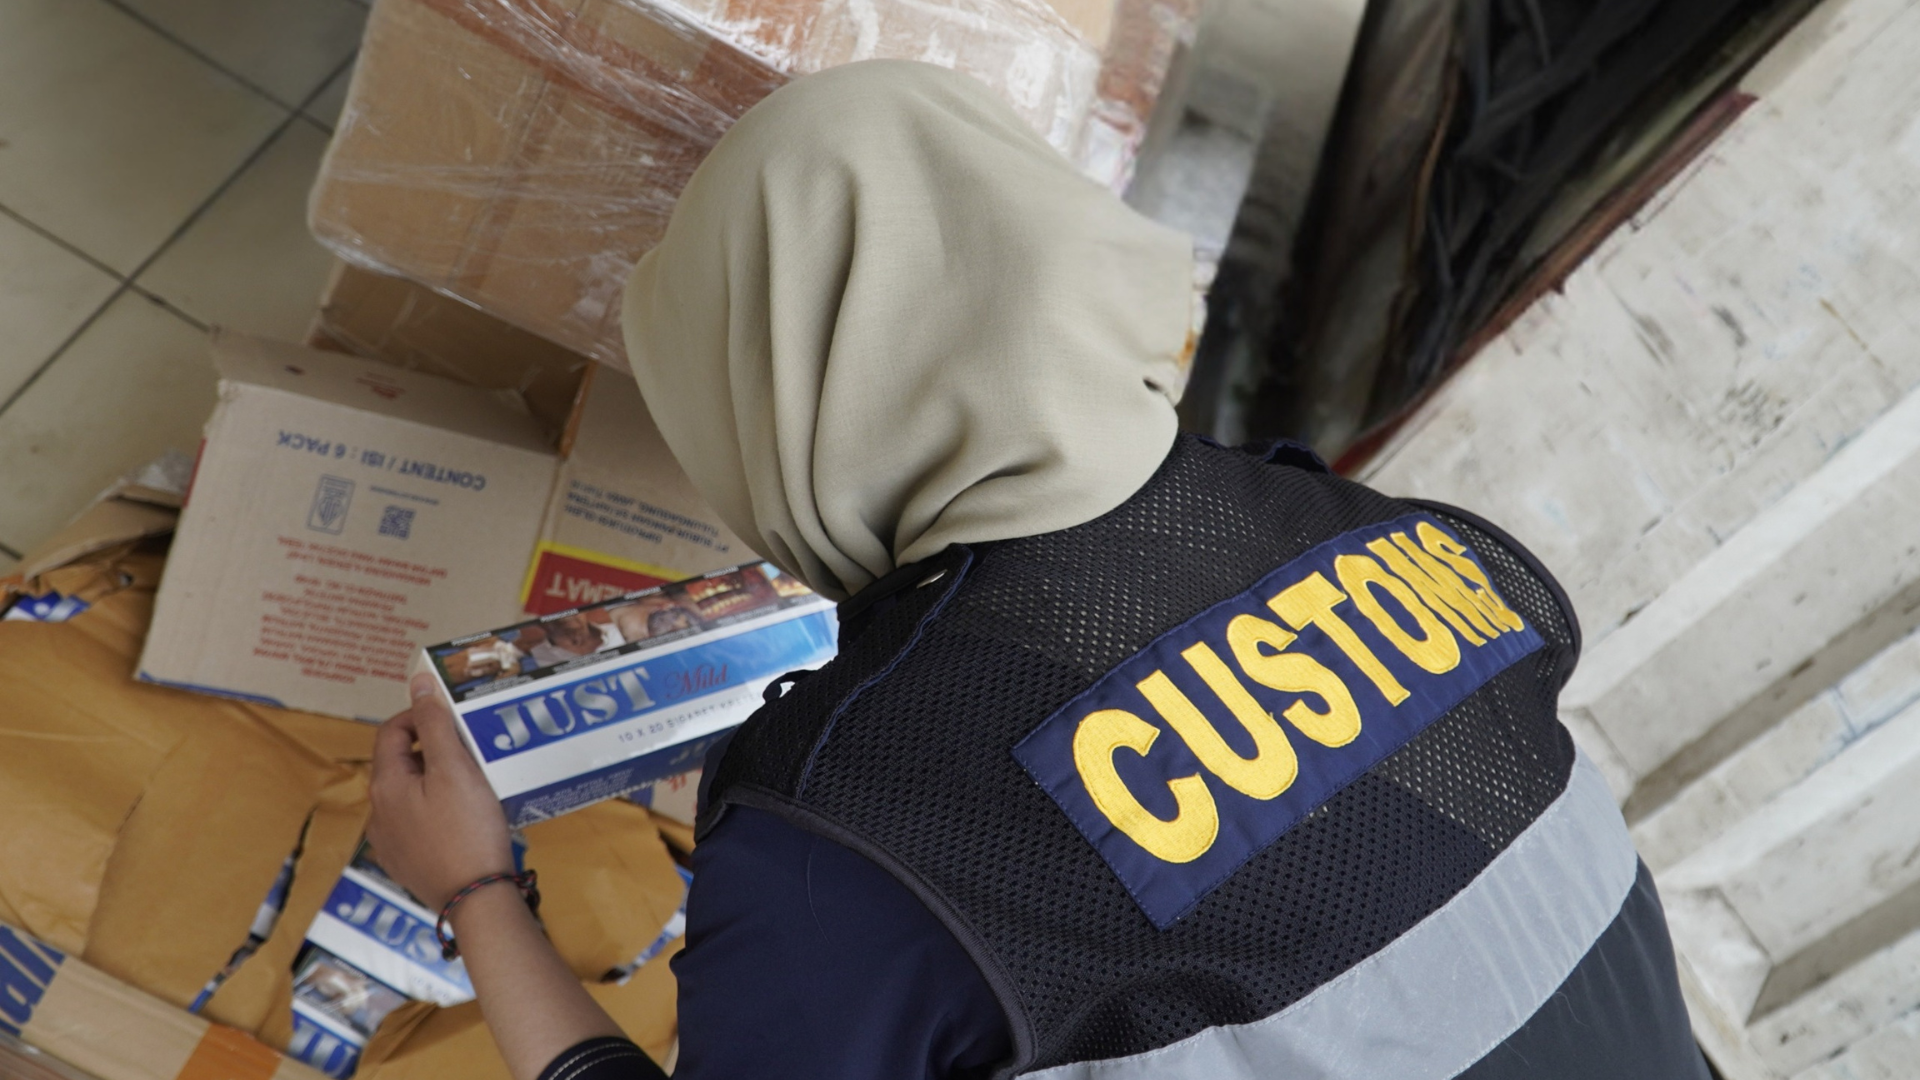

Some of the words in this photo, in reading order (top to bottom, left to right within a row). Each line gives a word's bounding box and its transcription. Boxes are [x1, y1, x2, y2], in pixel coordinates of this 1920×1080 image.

[277, 429, 330, 457] PACK
[334, 442, 347, 459] 6
[360, 449, 384, 467] ISI
[399, 459, 487, 491] CONTENT
[1072, 521, 1525, 863] CUSTOMS
[493, 666, 656, 751] JUST
[665, 663, 728, 700] Mild
[618, 731, 634, 743] 10
[650, 723, 664, 735] 20
